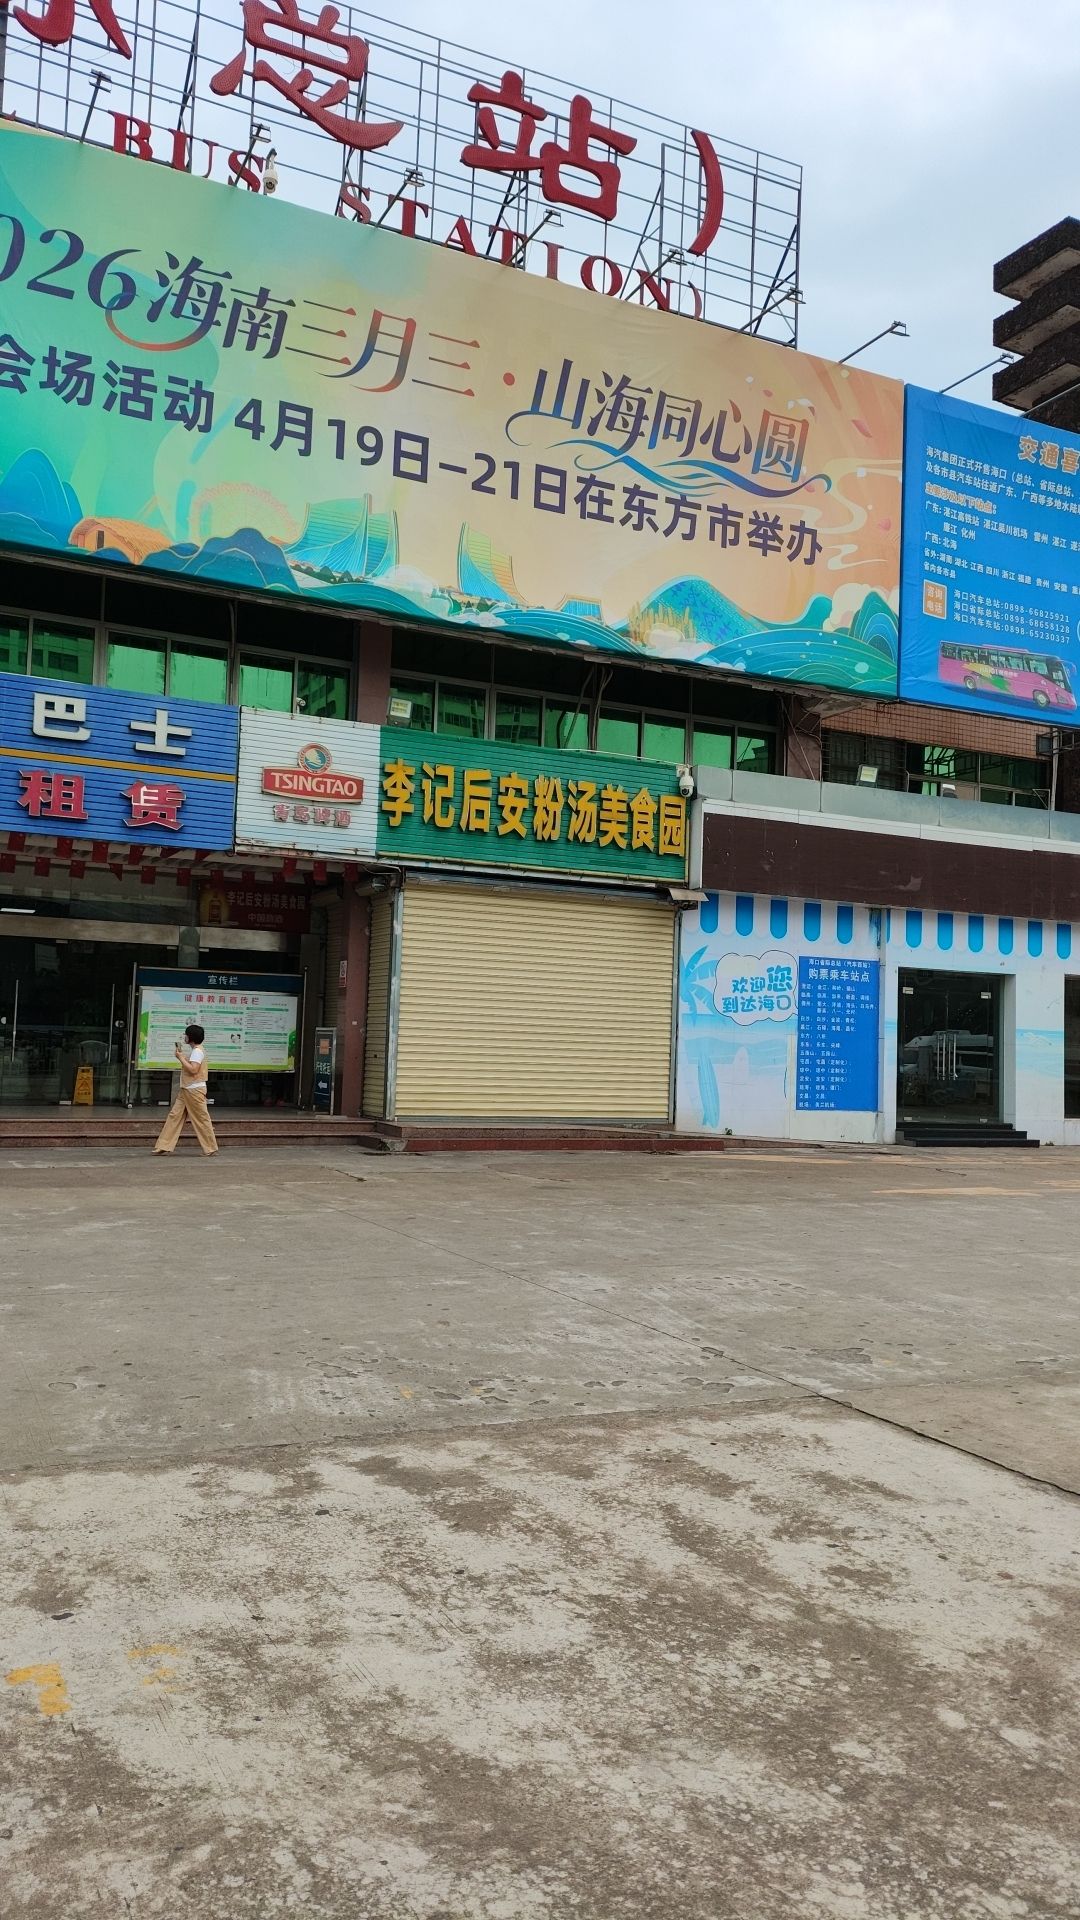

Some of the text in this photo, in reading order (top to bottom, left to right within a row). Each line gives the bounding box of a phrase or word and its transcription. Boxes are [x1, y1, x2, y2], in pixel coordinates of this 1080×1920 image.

[926, 461, 1080, 515] 及各市县汽车站往返广东、广西等多地水陆
[961, 527, 976, 541] 化州
[271, 771, 358, 797] TSINGTAO
[17, 769, 187, 831] 租赁
[381, 757, 687, 857] 李记后安粉汤美食园
[207, 974, 239, 986] 宣传栏
[732, 965, 793, 993] 欢迎您
[808, 968, 870, 983] 购票乘车站点
[722, 994, 792, 1014] 到达海口
